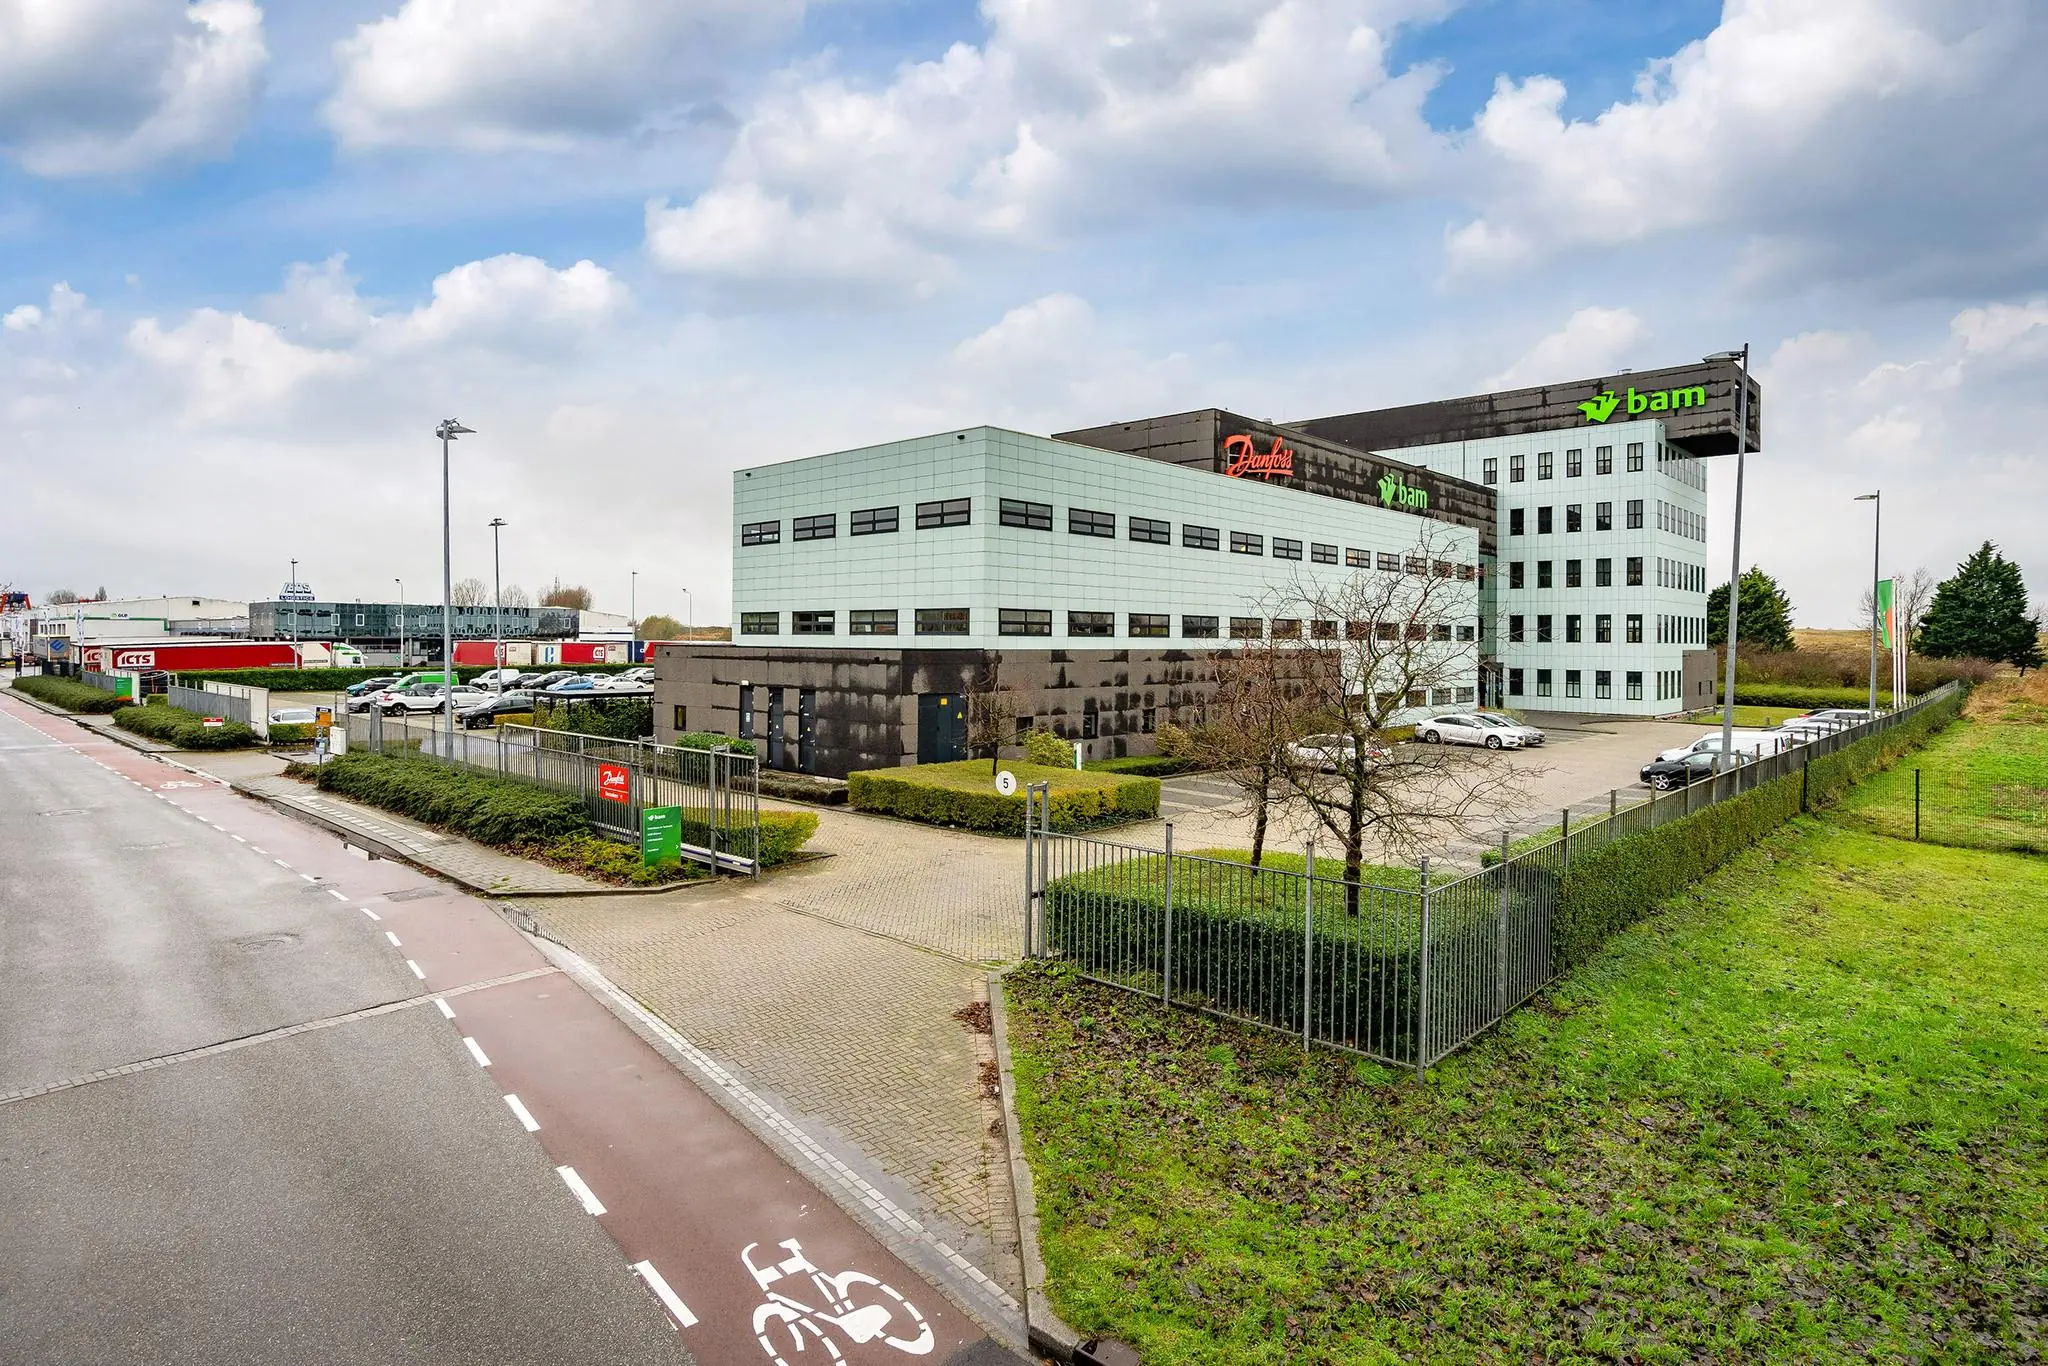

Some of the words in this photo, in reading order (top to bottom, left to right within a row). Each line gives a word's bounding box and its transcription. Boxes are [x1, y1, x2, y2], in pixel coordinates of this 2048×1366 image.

[1627, 385, 1706, 414] bam
[1223, 434, 1294, 480] Danfoss
[1399, 477, 1429, 509] bam
[121, 654, 152, 665] ICTS
[1002, 777, 1009, 789] 5
